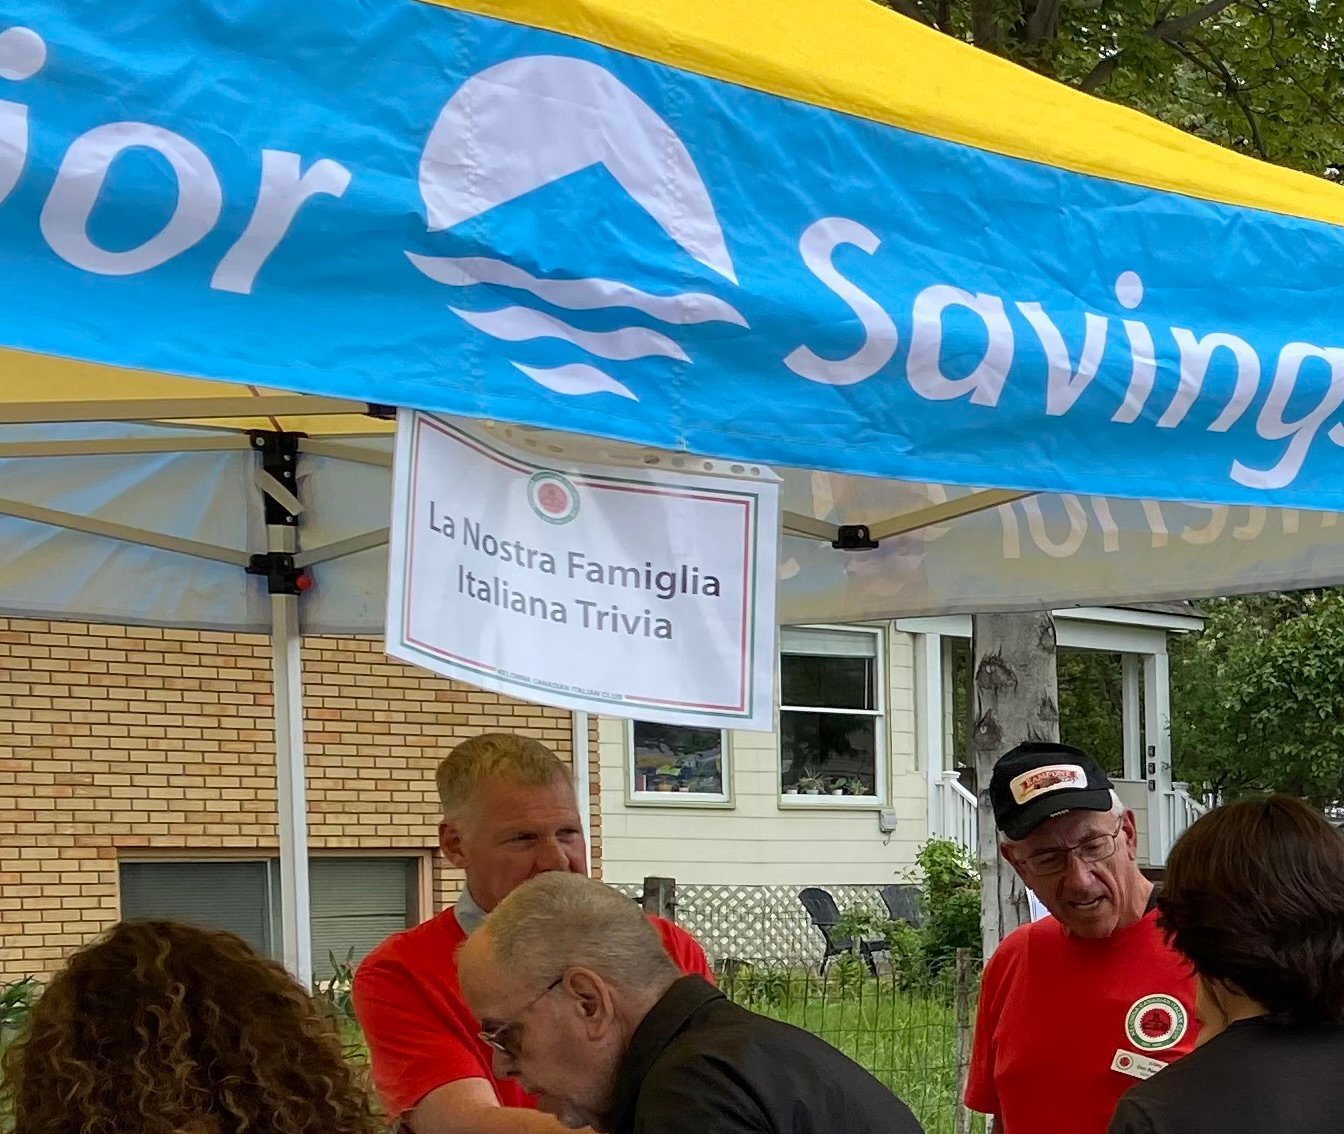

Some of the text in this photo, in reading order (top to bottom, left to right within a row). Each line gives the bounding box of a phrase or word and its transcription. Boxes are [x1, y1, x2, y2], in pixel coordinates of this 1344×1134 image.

[429, 500, 721, 600] La Nostra Famiglia
[457, 564, 673, 640] Italiana Trivia
